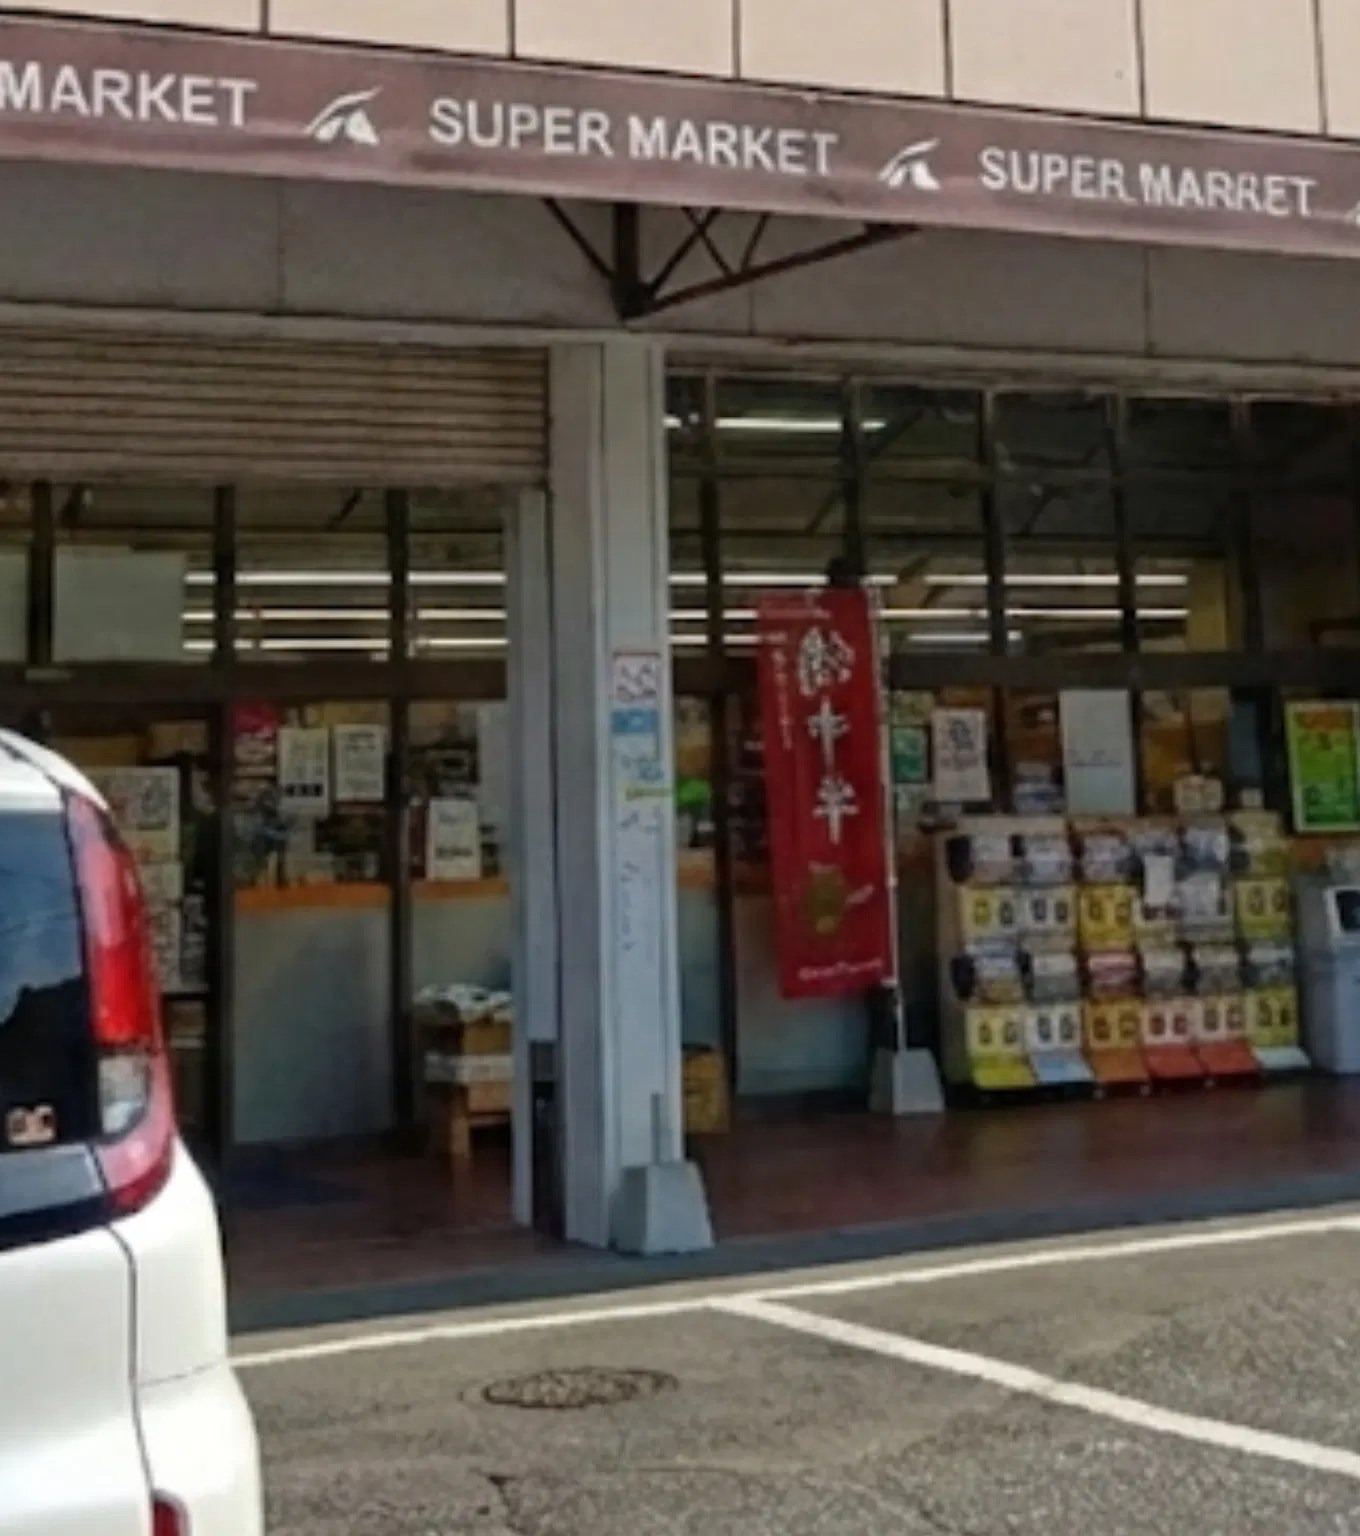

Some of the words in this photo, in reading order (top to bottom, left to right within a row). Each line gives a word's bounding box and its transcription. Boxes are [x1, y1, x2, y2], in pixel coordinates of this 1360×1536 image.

[427, 97, 614, 156] SUPER
[627, 115, 838, 176] MARKET
[979, 146, 1136, 204] SUPER
